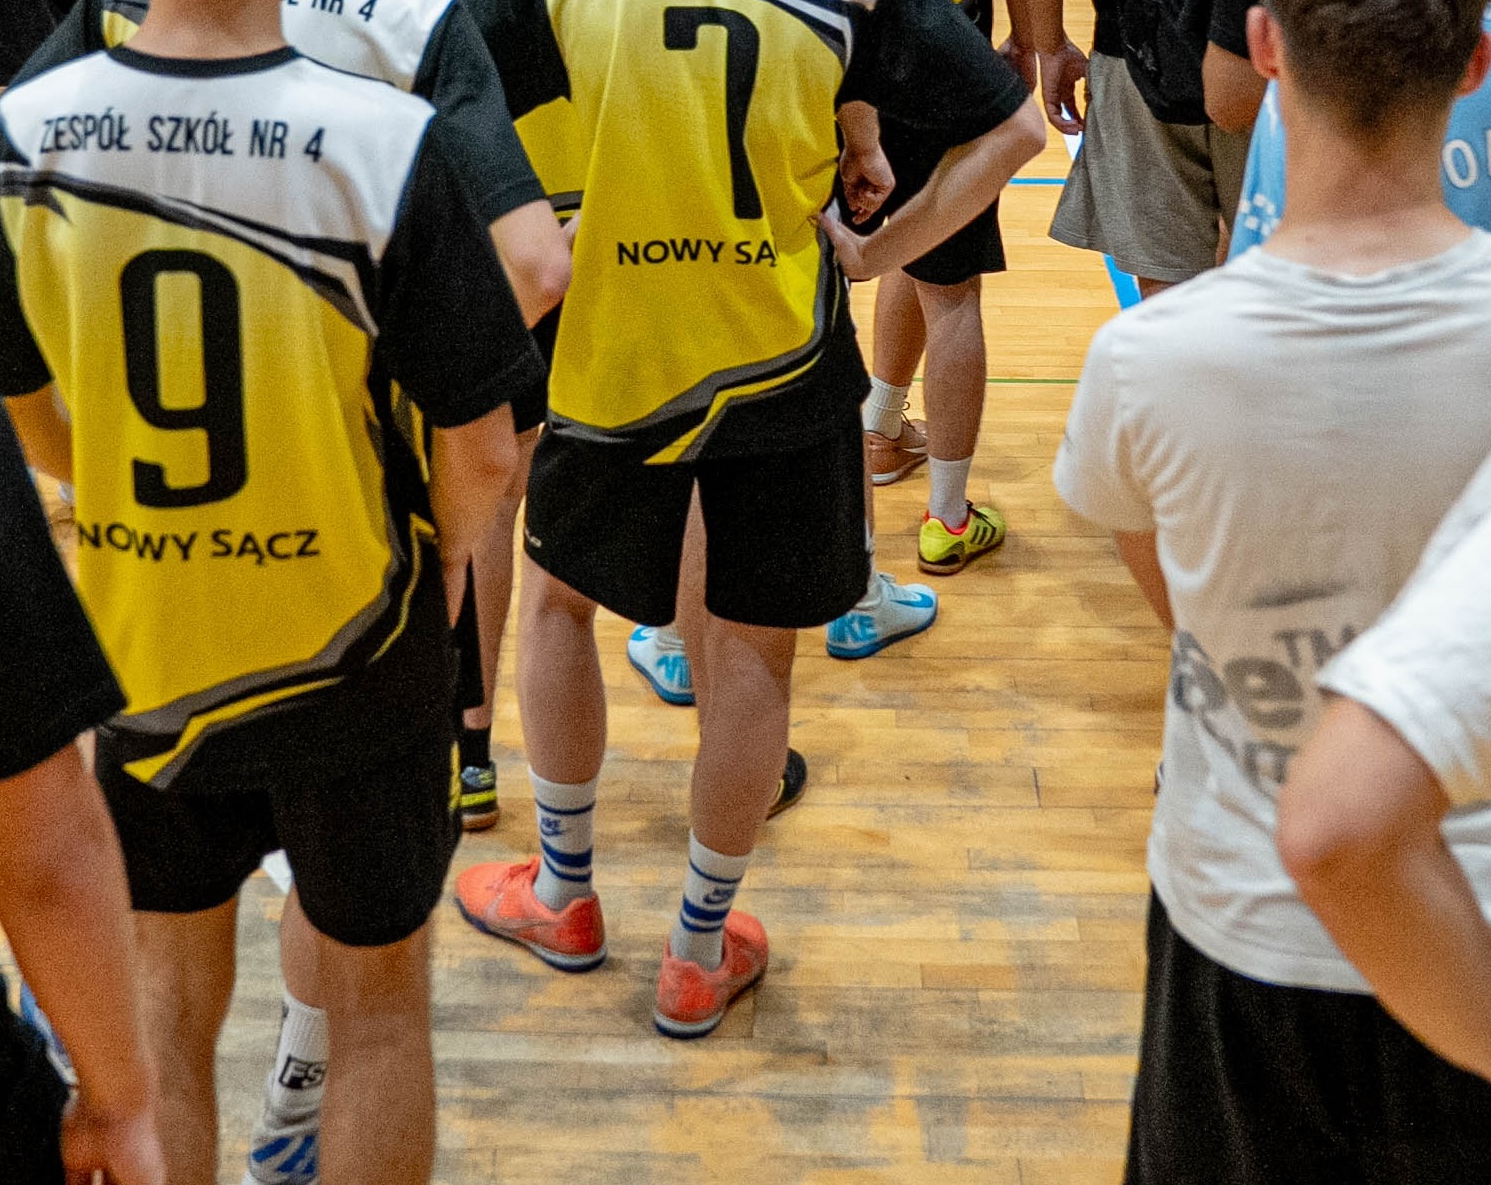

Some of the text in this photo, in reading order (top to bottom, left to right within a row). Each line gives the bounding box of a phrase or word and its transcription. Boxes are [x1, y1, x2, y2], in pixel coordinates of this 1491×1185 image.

[39, 107, 326, 162] ZESPÓŁ SZKÓŁ NR 4
[663, 5, 765, 221] 7
[616, 237, 725, 266] NOWY
[120, 246, 250, 511] 9
[77, 521, 322, 567] NOWY SĄCZ
